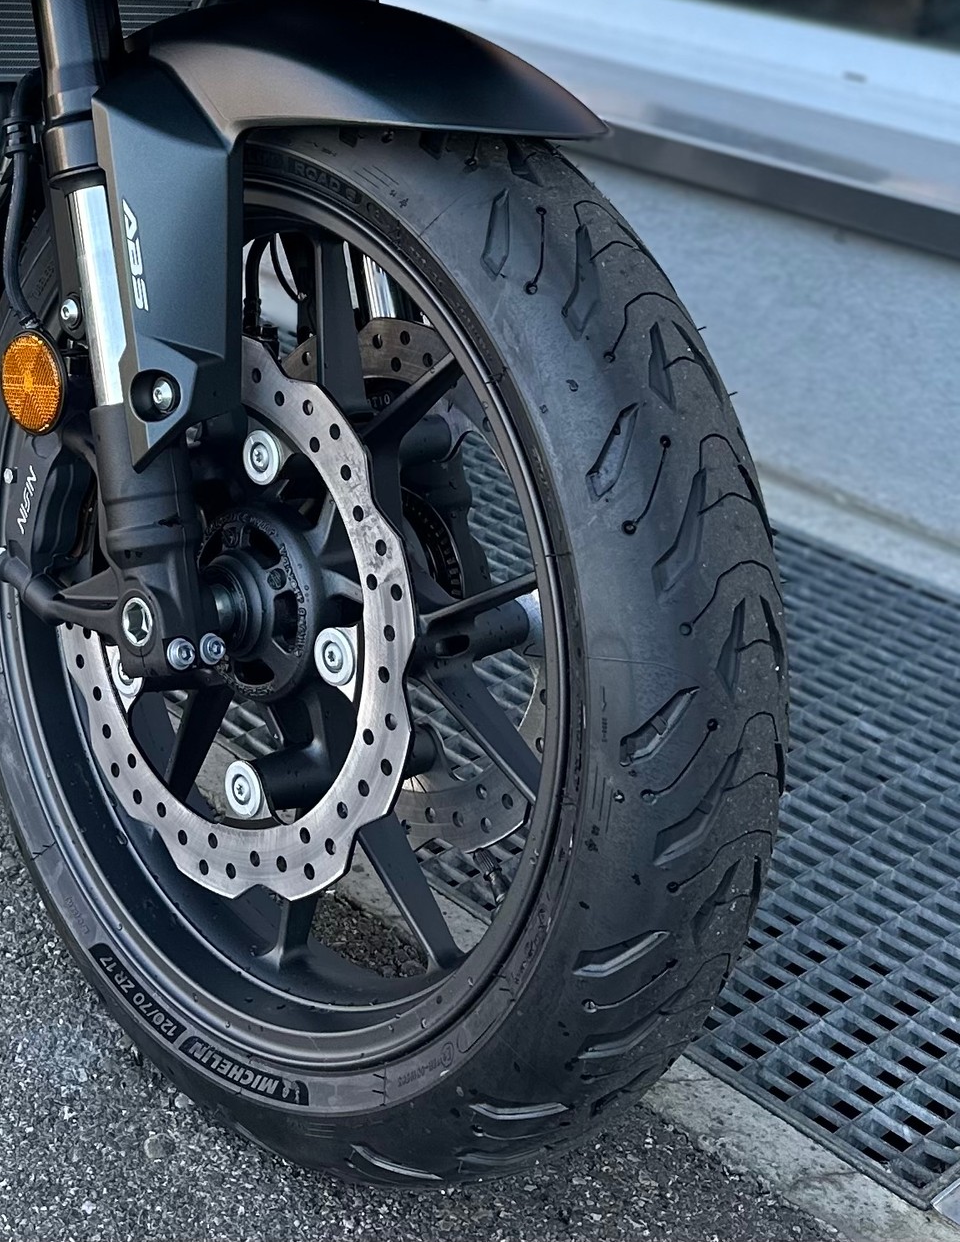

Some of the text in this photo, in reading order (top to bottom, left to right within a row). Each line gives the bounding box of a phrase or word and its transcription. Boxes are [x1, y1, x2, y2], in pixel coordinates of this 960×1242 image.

[294, 160, 341, 193] ROAD
[121, 197, 149, 312] ABS
[17, 464, 37, 535] NISSIN
[100, 956, 279, 1095] MICHELIN 120/70 ZR 17
